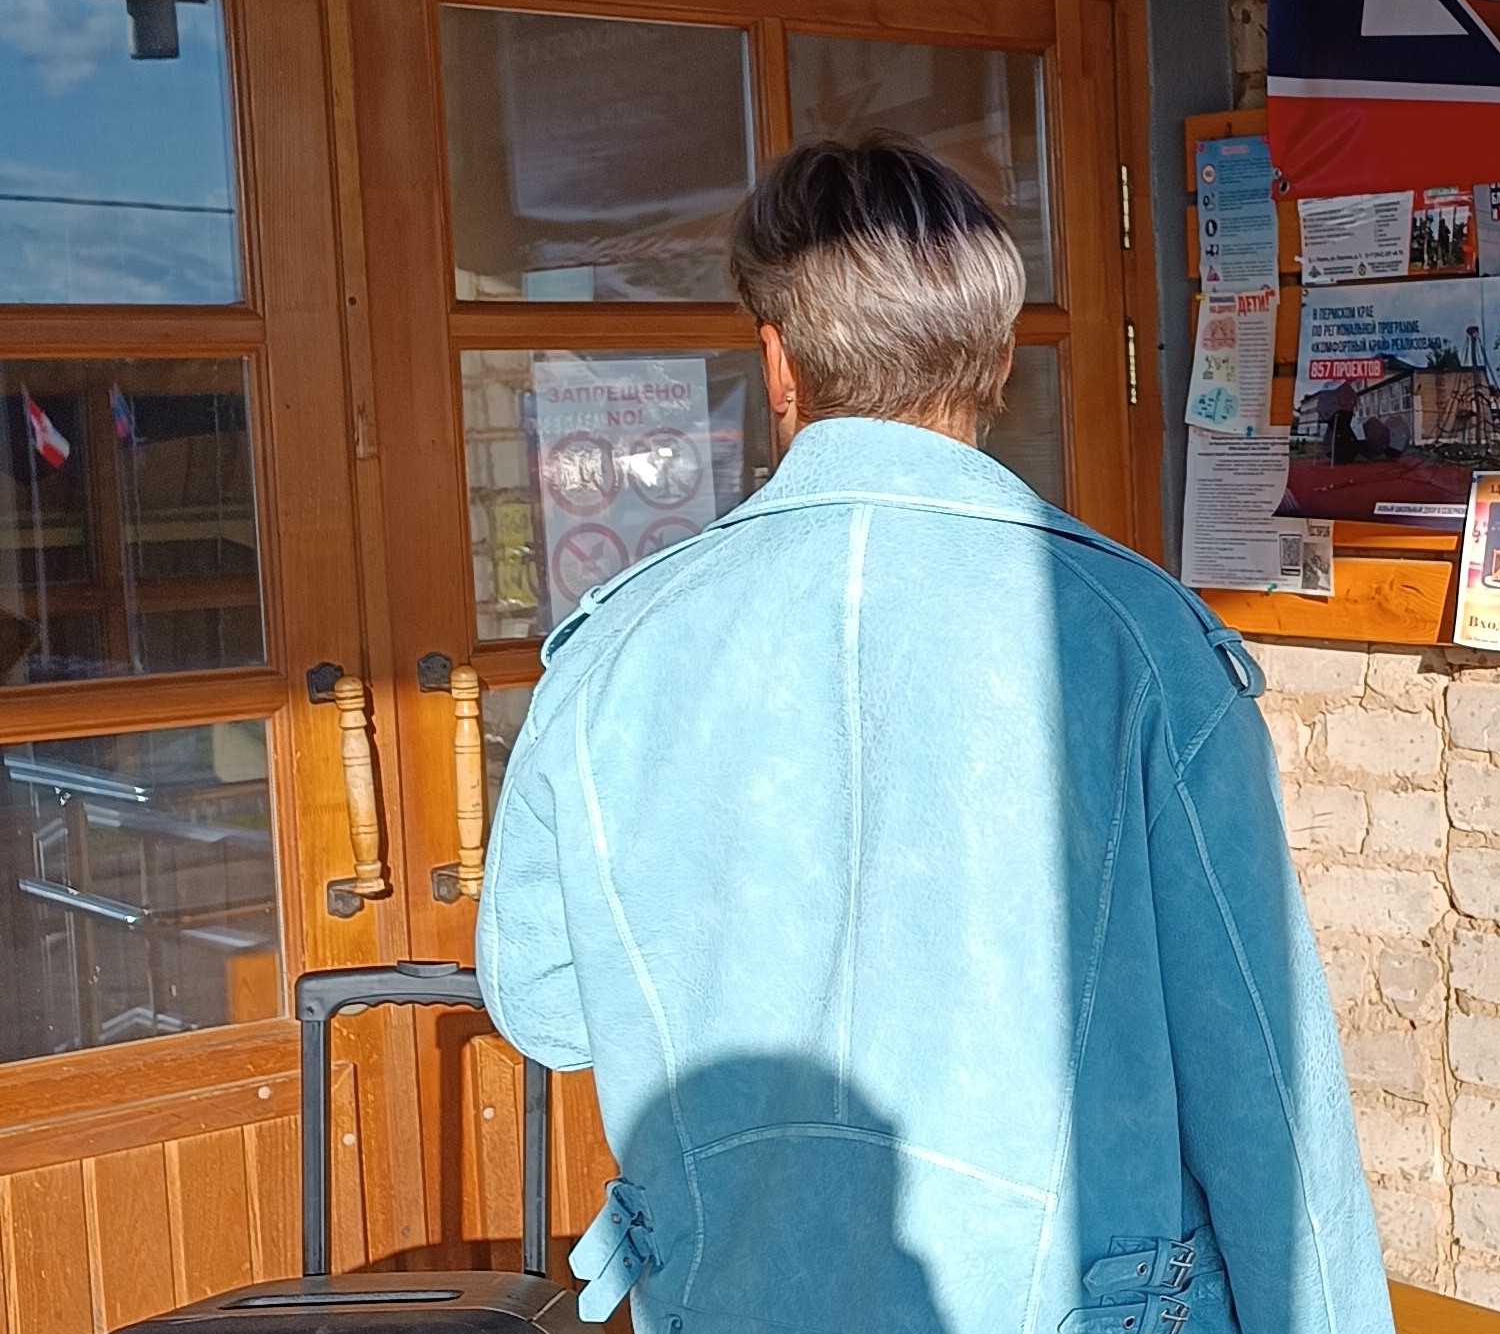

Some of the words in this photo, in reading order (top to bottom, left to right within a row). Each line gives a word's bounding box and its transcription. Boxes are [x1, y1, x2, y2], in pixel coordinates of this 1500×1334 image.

[1311, 361, 1331, 378] 857
[1333, 360, 1381, 377] ПРОЕКТОВ
[548, 383, 692, 403] ЗАПРЕЩЕНО!
[606, 409, 644, 427] NO!
